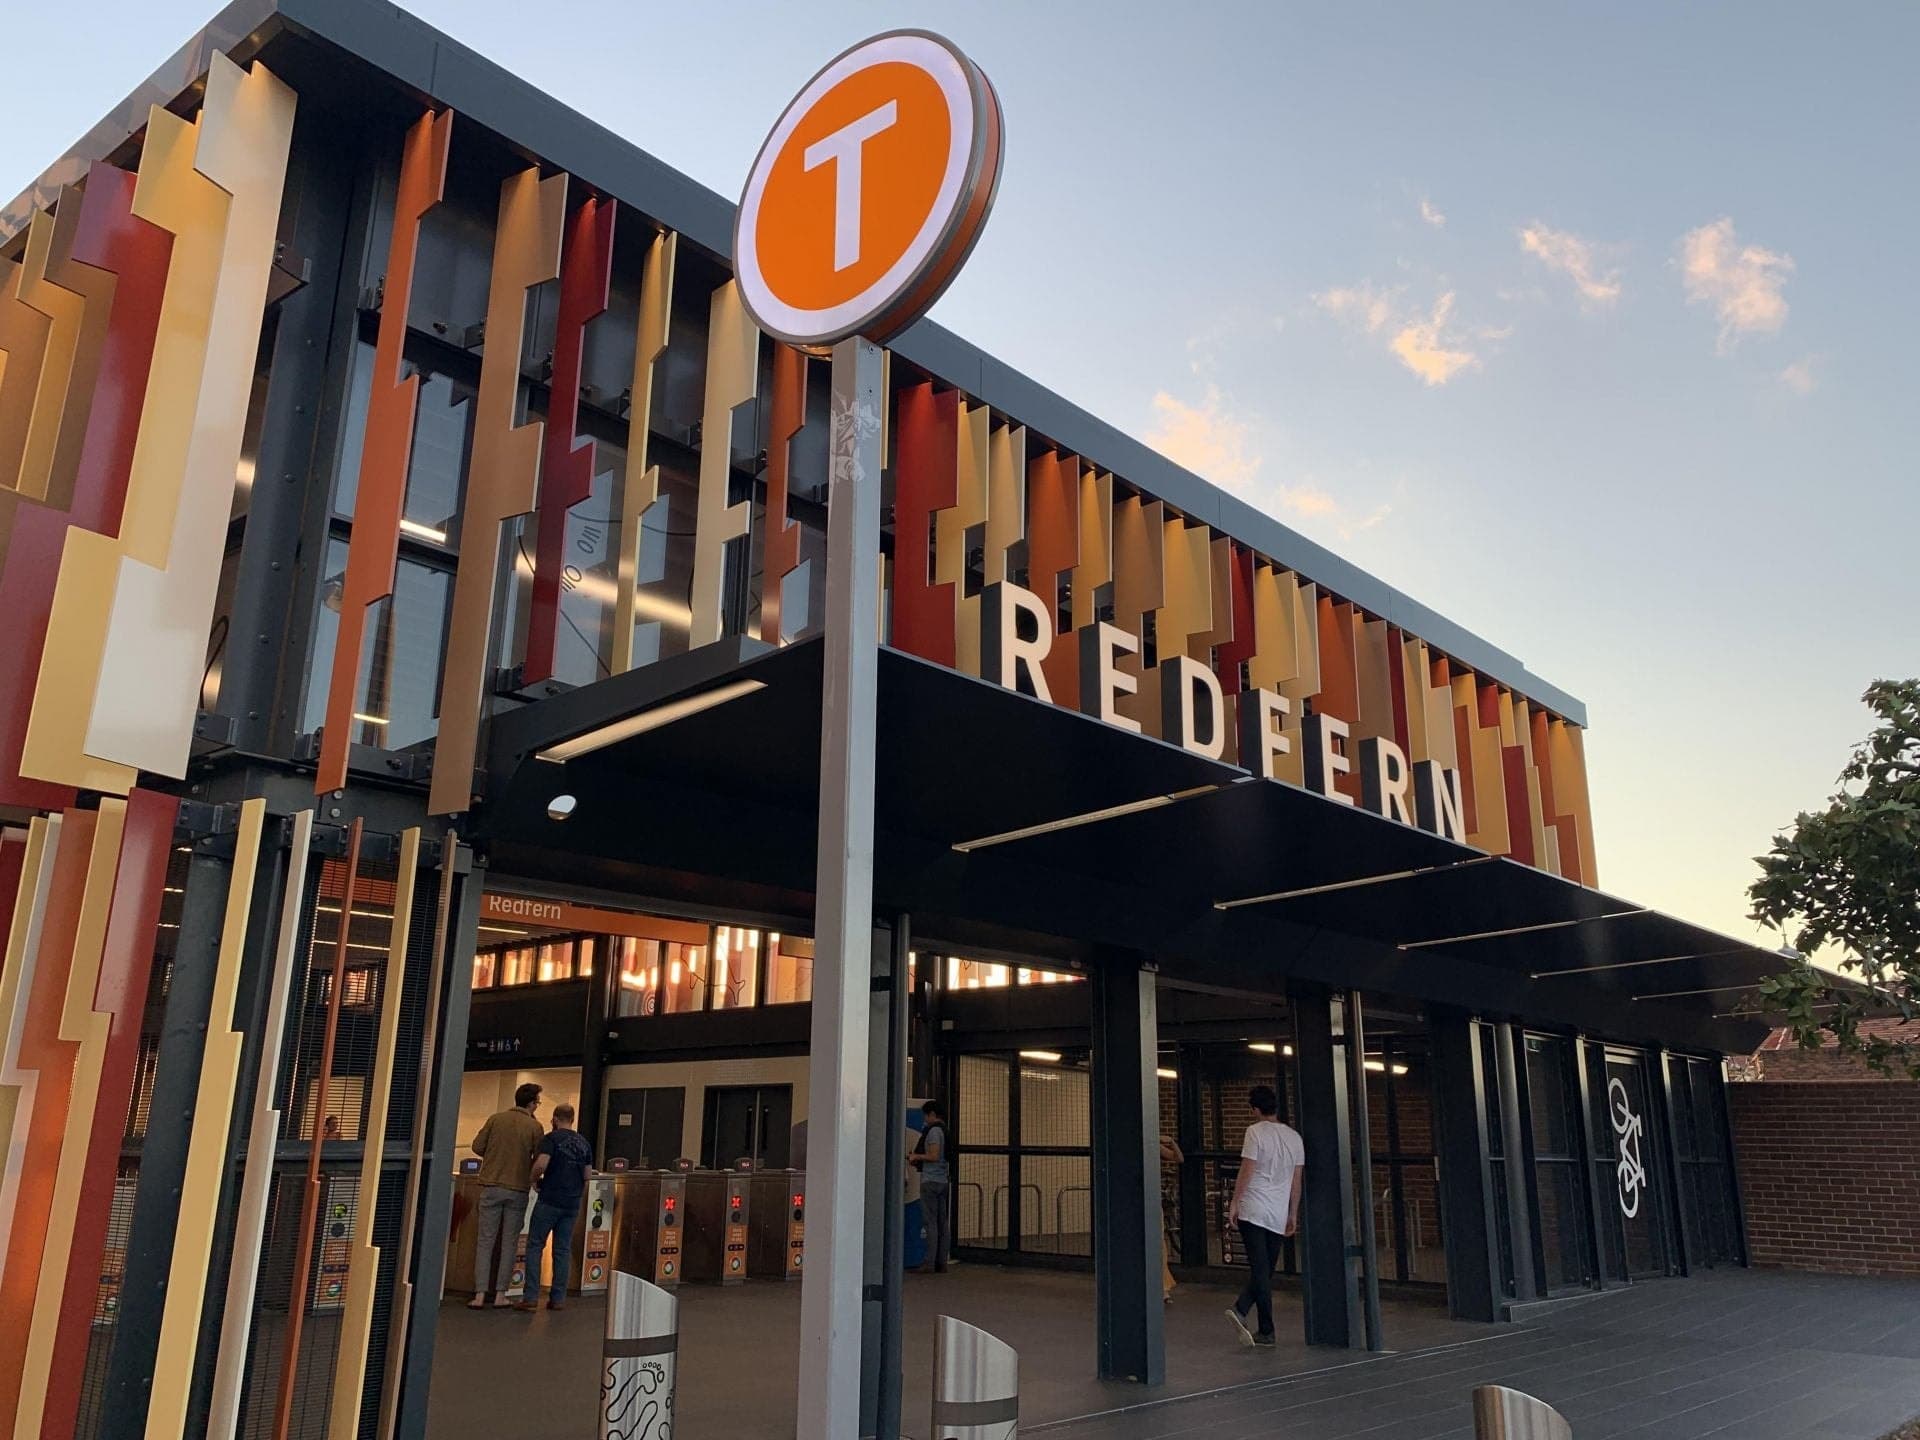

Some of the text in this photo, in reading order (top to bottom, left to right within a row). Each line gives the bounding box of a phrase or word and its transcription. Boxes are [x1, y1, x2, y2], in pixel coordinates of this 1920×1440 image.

[803, 98, 897, 273] T
[1000, 580, 1466, 844] REDFERN
[489, 896, 561, 919] Redfern
